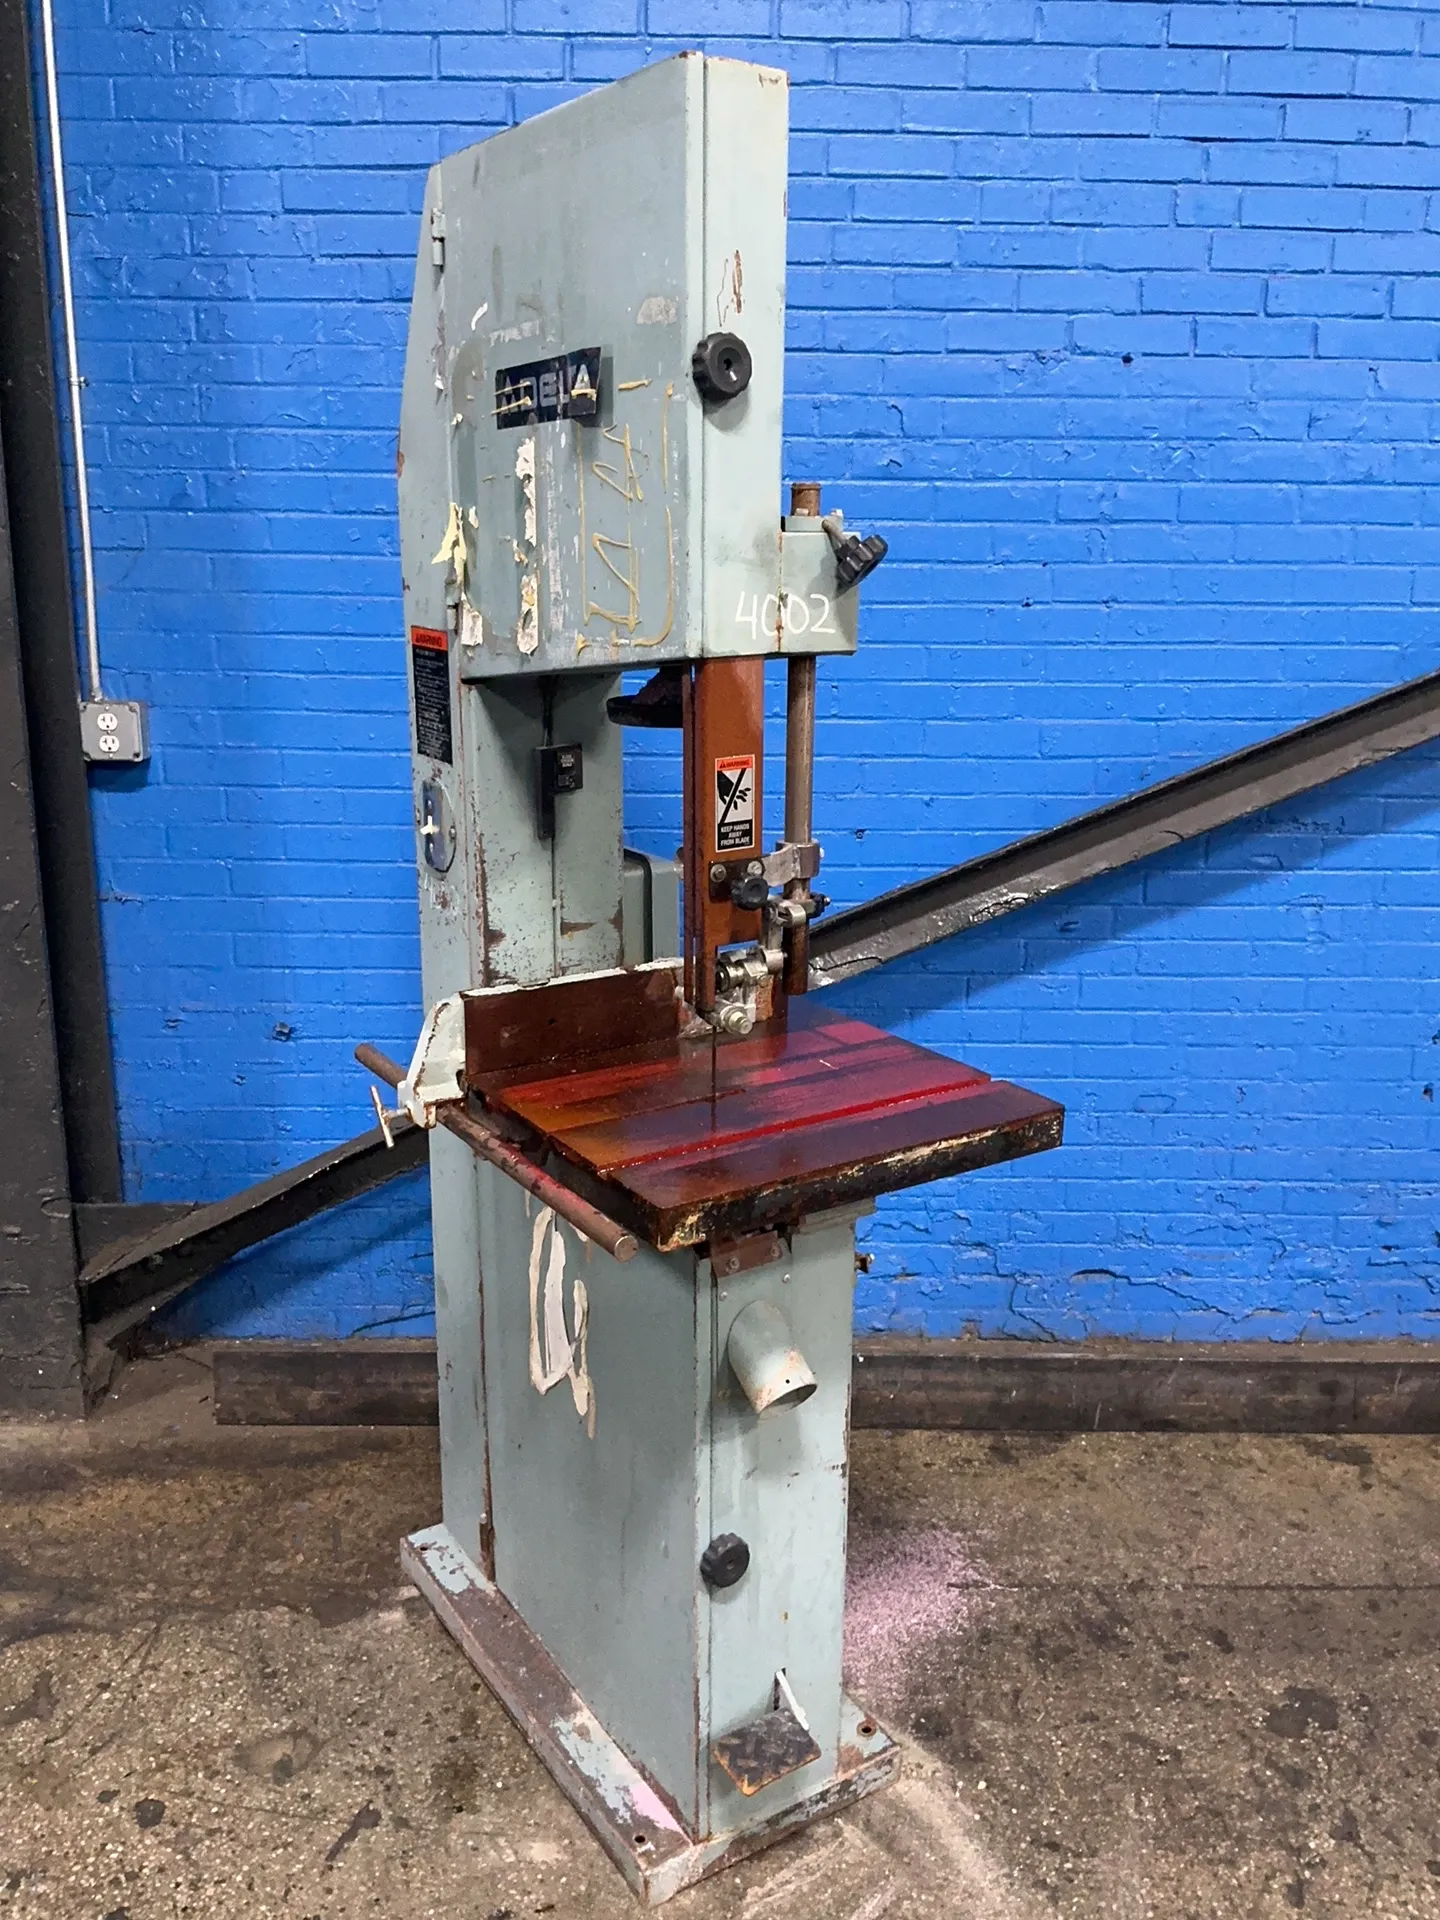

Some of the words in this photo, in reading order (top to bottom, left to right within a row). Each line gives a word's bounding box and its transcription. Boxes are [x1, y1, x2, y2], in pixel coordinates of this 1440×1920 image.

[735, 591, 836, 640] 4002
[726, 759, 750, 767] WARNING
[720, 825, 733, 833] KEEP
[733, 823, 750, 831] HANDS
[735, 836, 750, 844] BLADE
